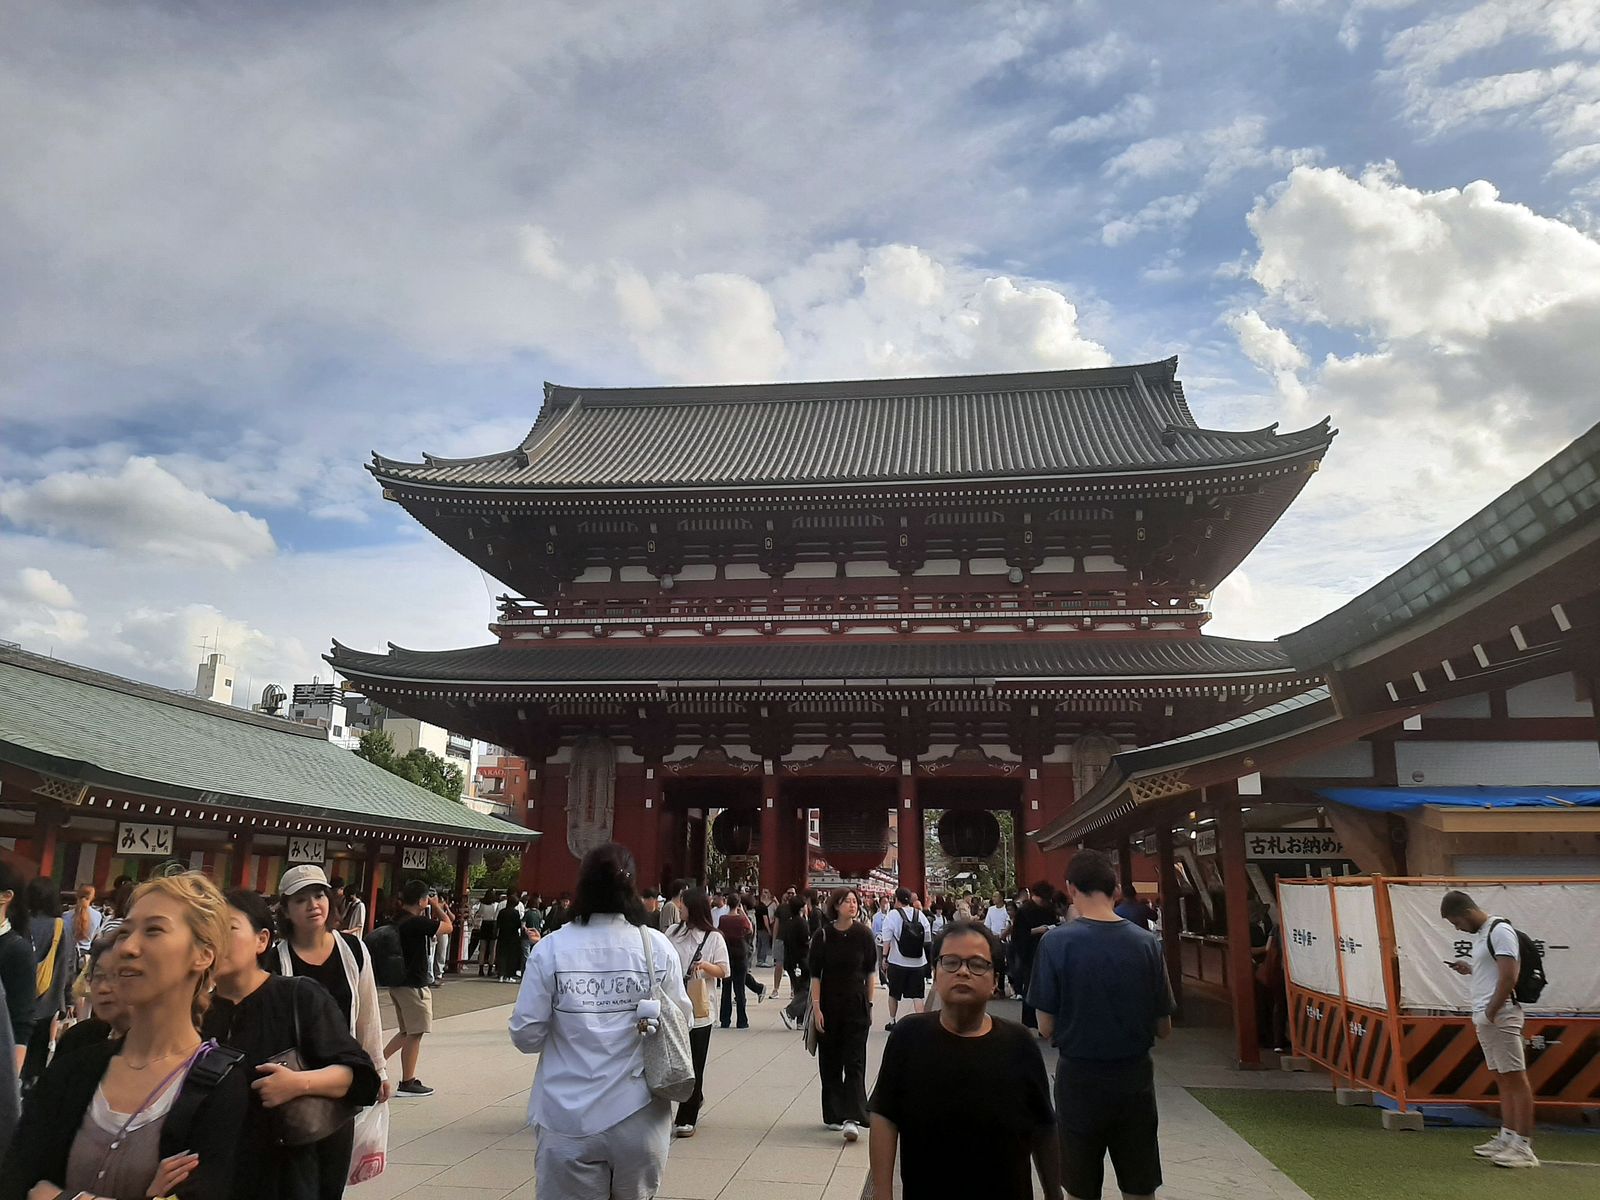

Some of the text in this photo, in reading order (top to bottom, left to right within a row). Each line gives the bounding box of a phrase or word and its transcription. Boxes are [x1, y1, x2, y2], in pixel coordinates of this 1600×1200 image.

[122, 828, 168, 849] みくじ
[291, 841, 321, 858] みくじ
[404, 851, 424, 865] みくじ
